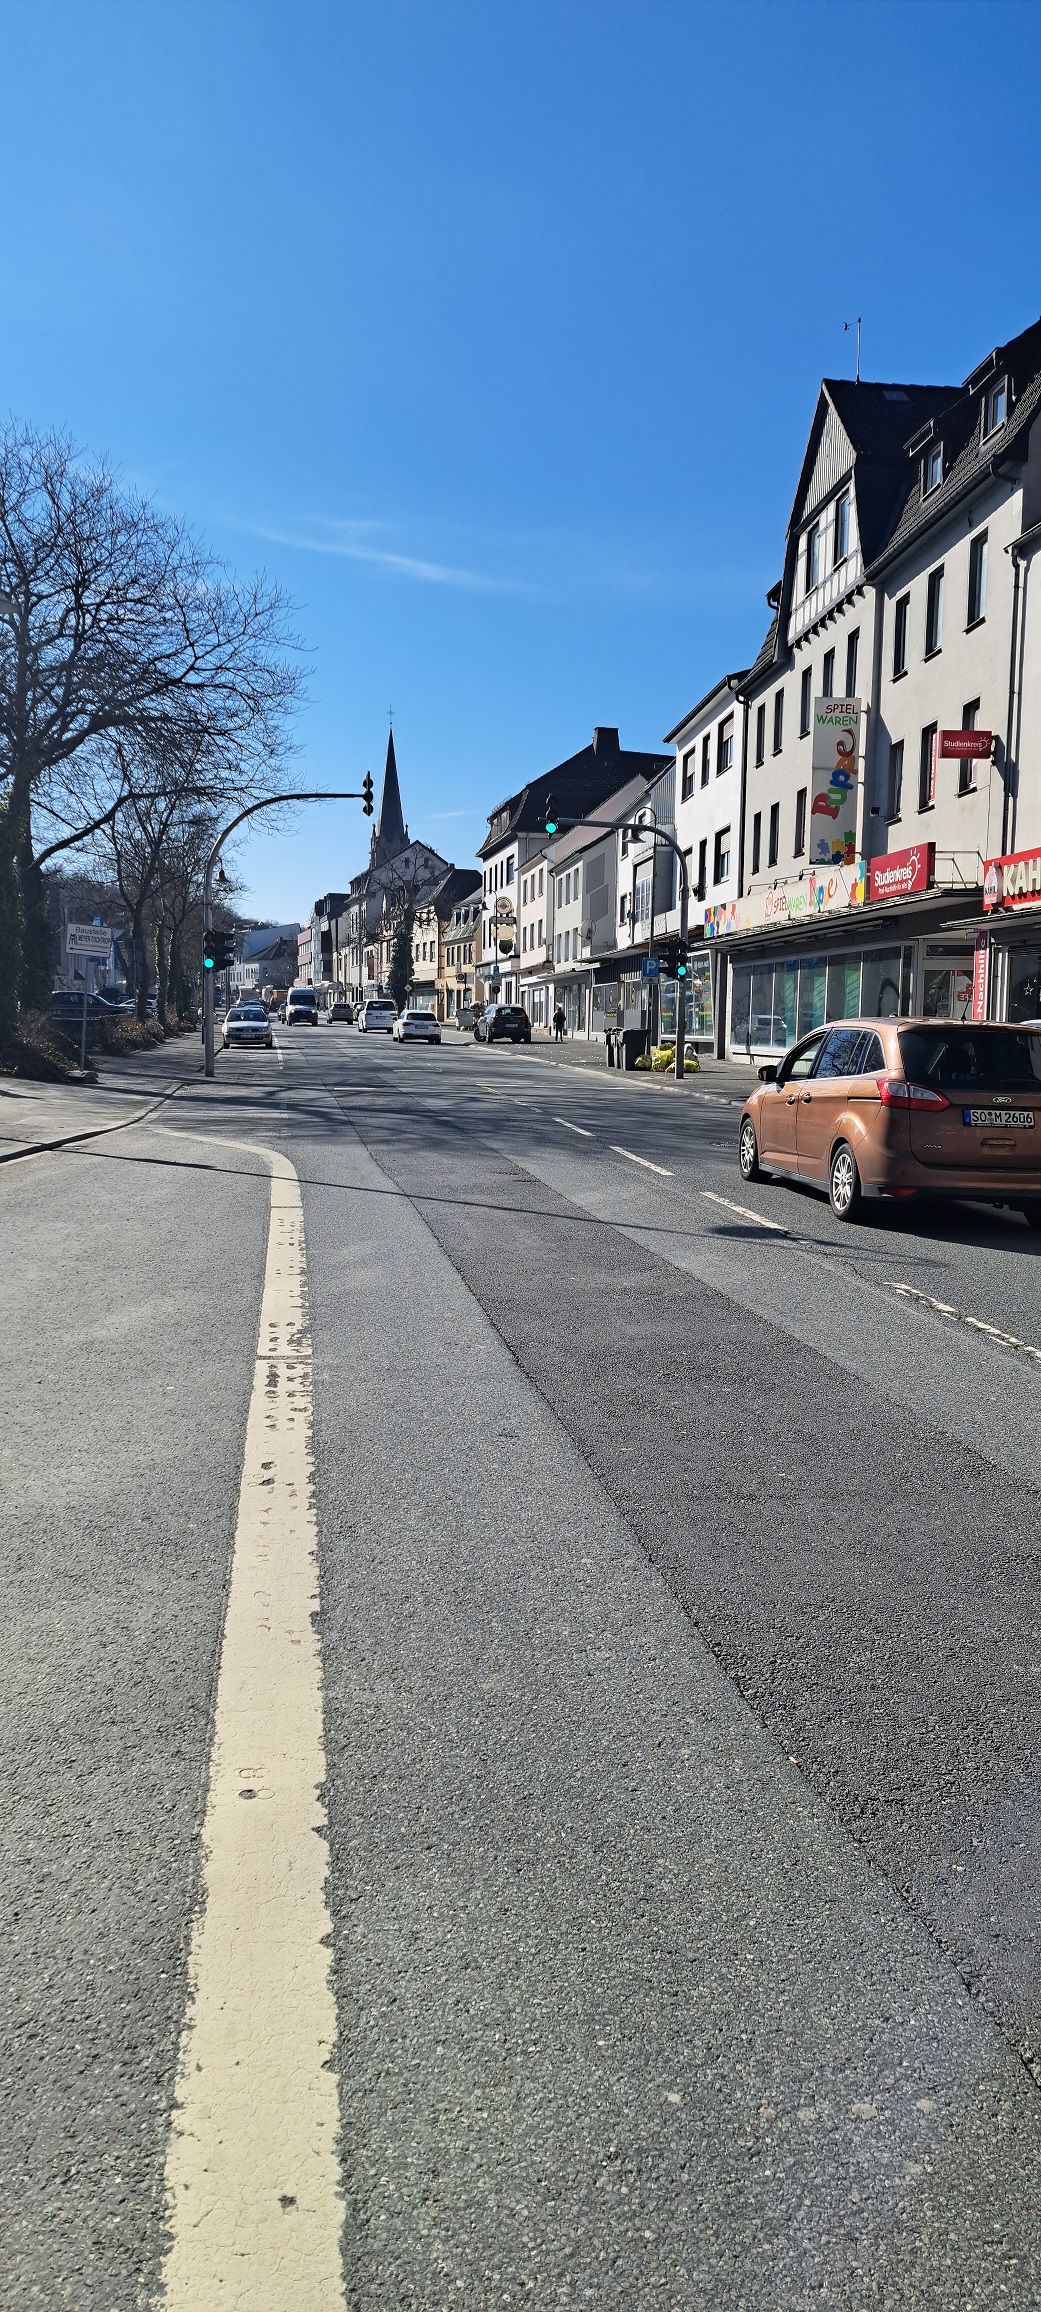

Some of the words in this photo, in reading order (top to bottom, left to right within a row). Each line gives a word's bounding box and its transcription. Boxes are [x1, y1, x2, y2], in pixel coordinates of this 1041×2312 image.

[825, 703, 858, 715] SPIEL
[816, 714, 858, 726] WAREN
[944, 740, 983, 748] Studienkreis
[811, 728, 858, 820] Puppe
[874, 862, 912, 887] Studienkreis
[76, 926, 107, 937] Baustelle
[646, 960, 657, 974] P
[972, 1111, 987, 1123] SO
[994, 1112, 1002, 1123] M
[1004, 1112, 1033, 1124] 2606
